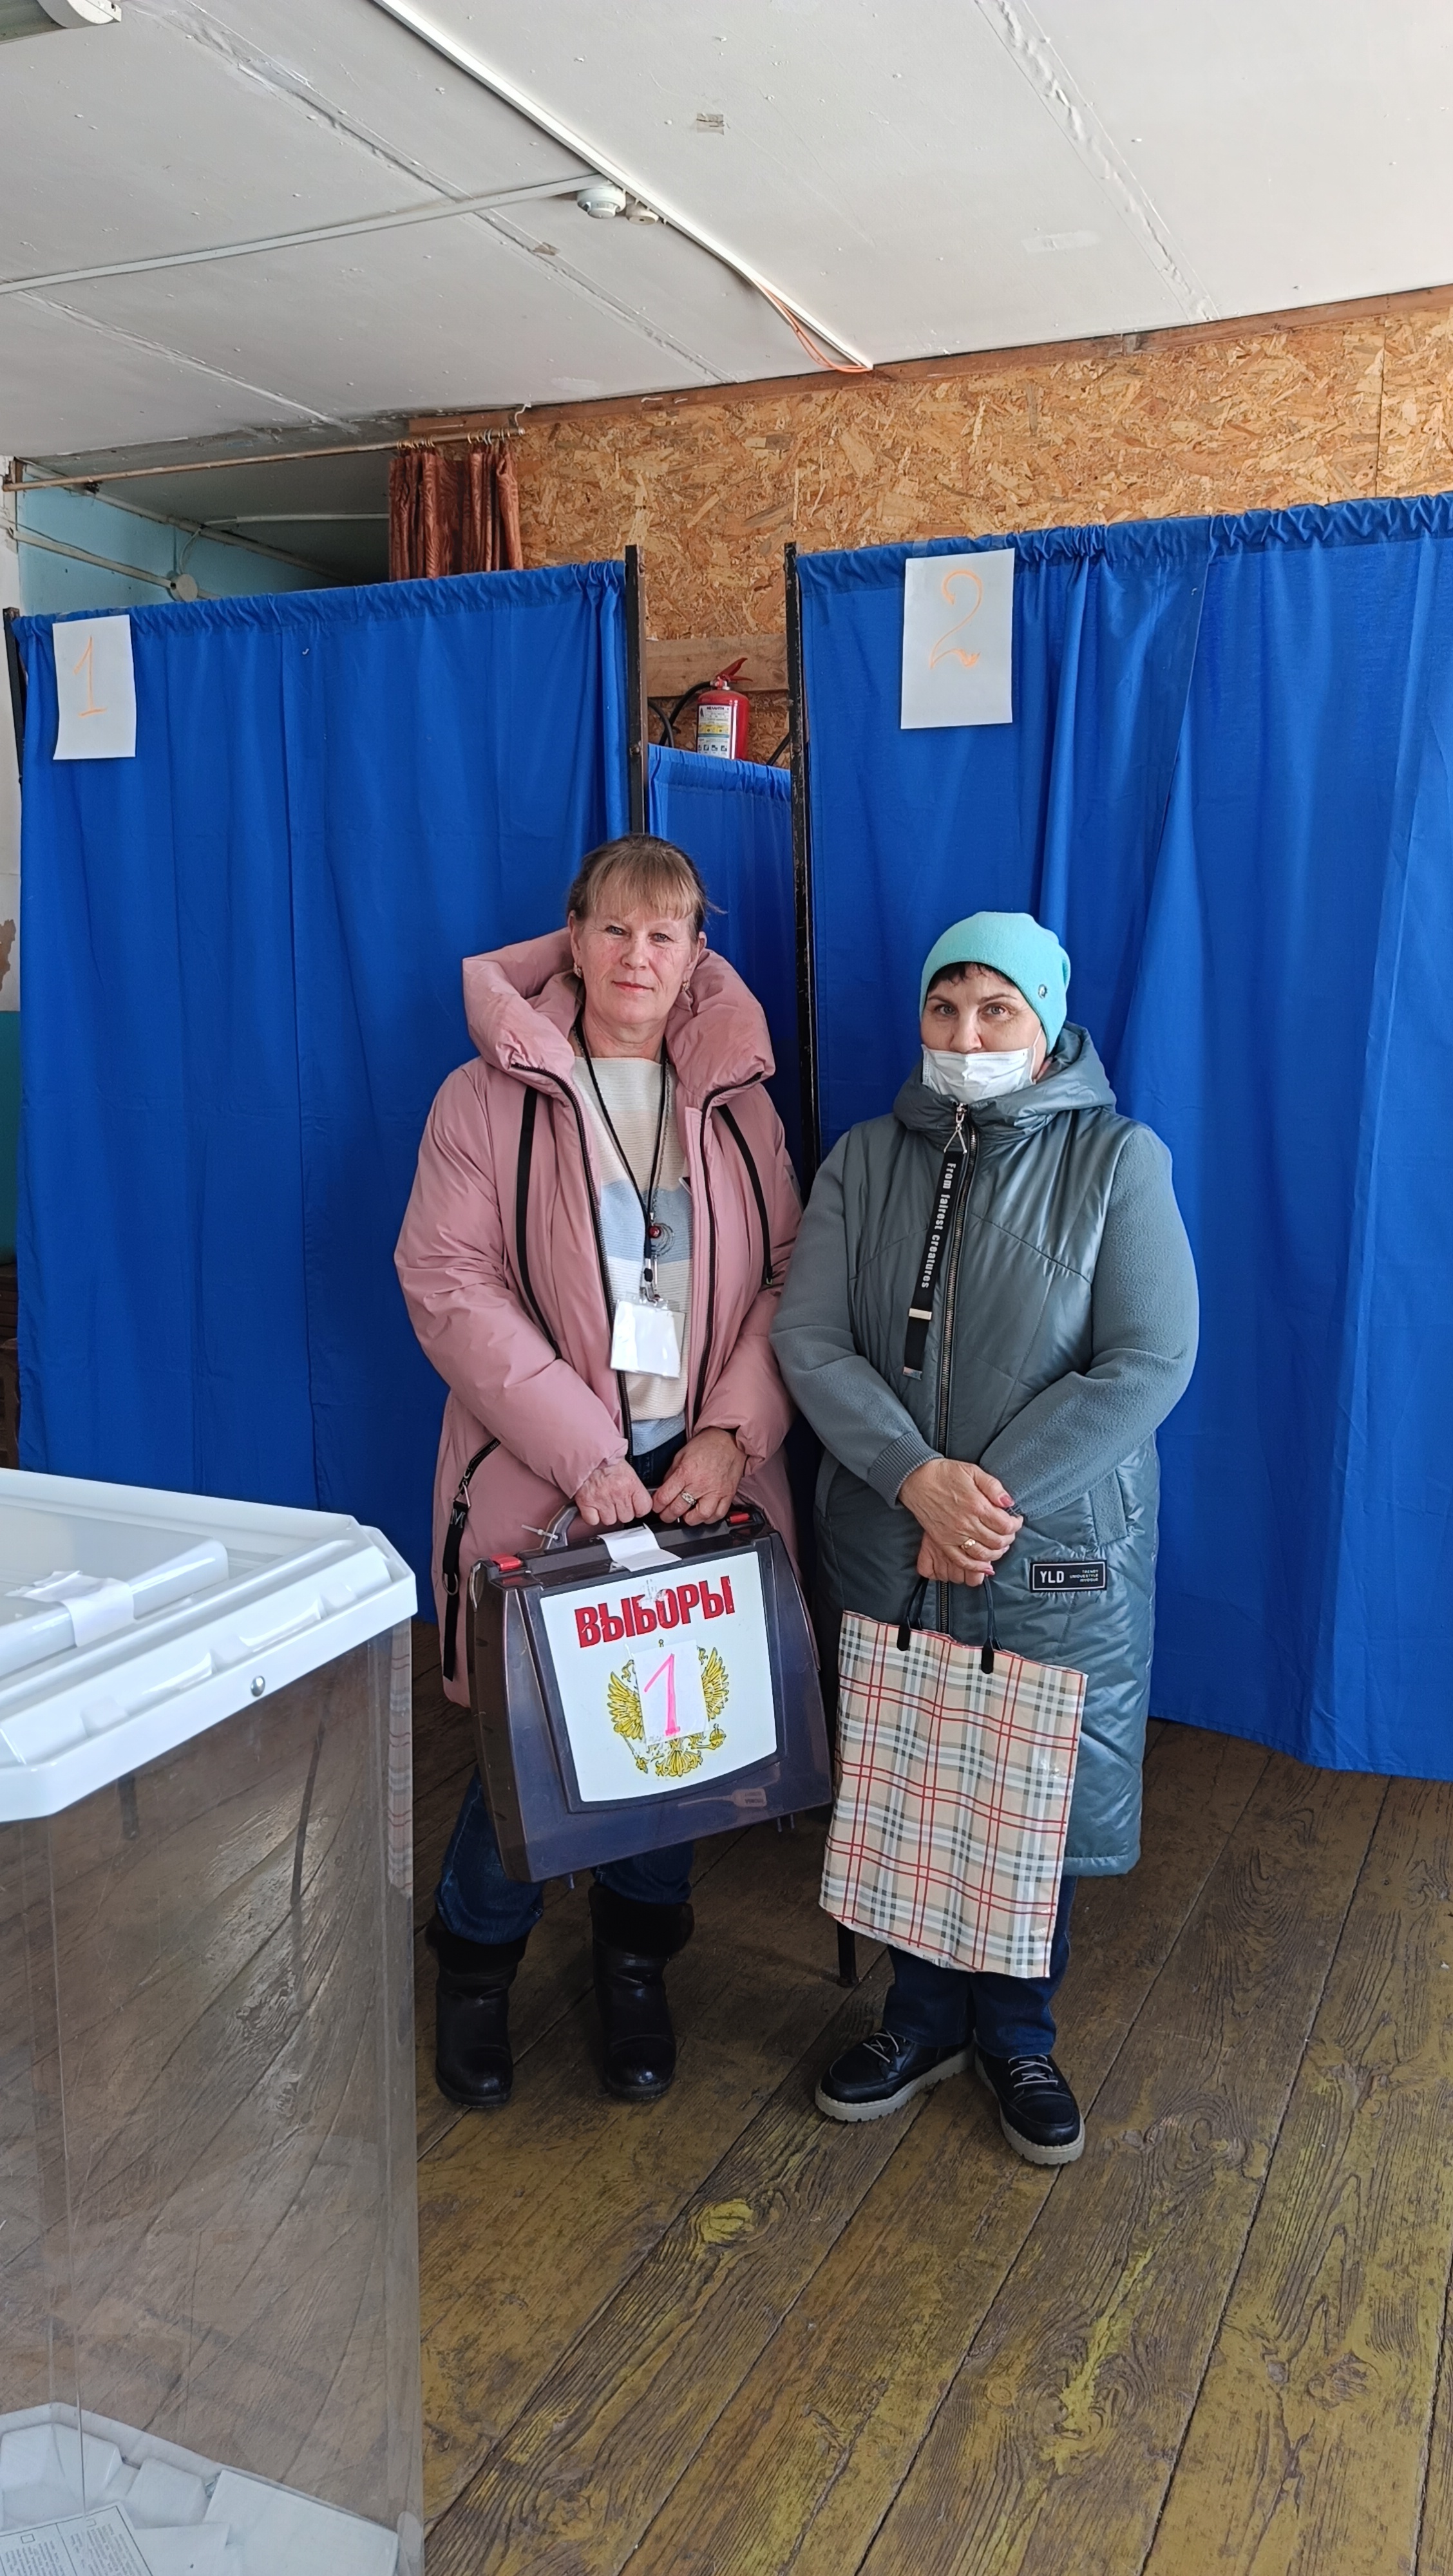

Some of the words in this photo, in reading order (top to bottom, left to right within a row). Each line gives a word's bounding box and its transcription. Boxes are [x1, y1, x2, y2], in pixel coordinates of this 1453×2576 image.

[929, 567, 983, 670] 2
[72, 635, 108, 720] 1
[942, 1162, 956, 1189] From
[934, 1193, 951, 1230] fairest
[921, 1234, 940, 1289] creatures
[1040, 1571, 1065, 1584] YLD
[575, 1575, 736, 1649] ВЫБОРЫ
[644, 1653, 681, 1736] 1
